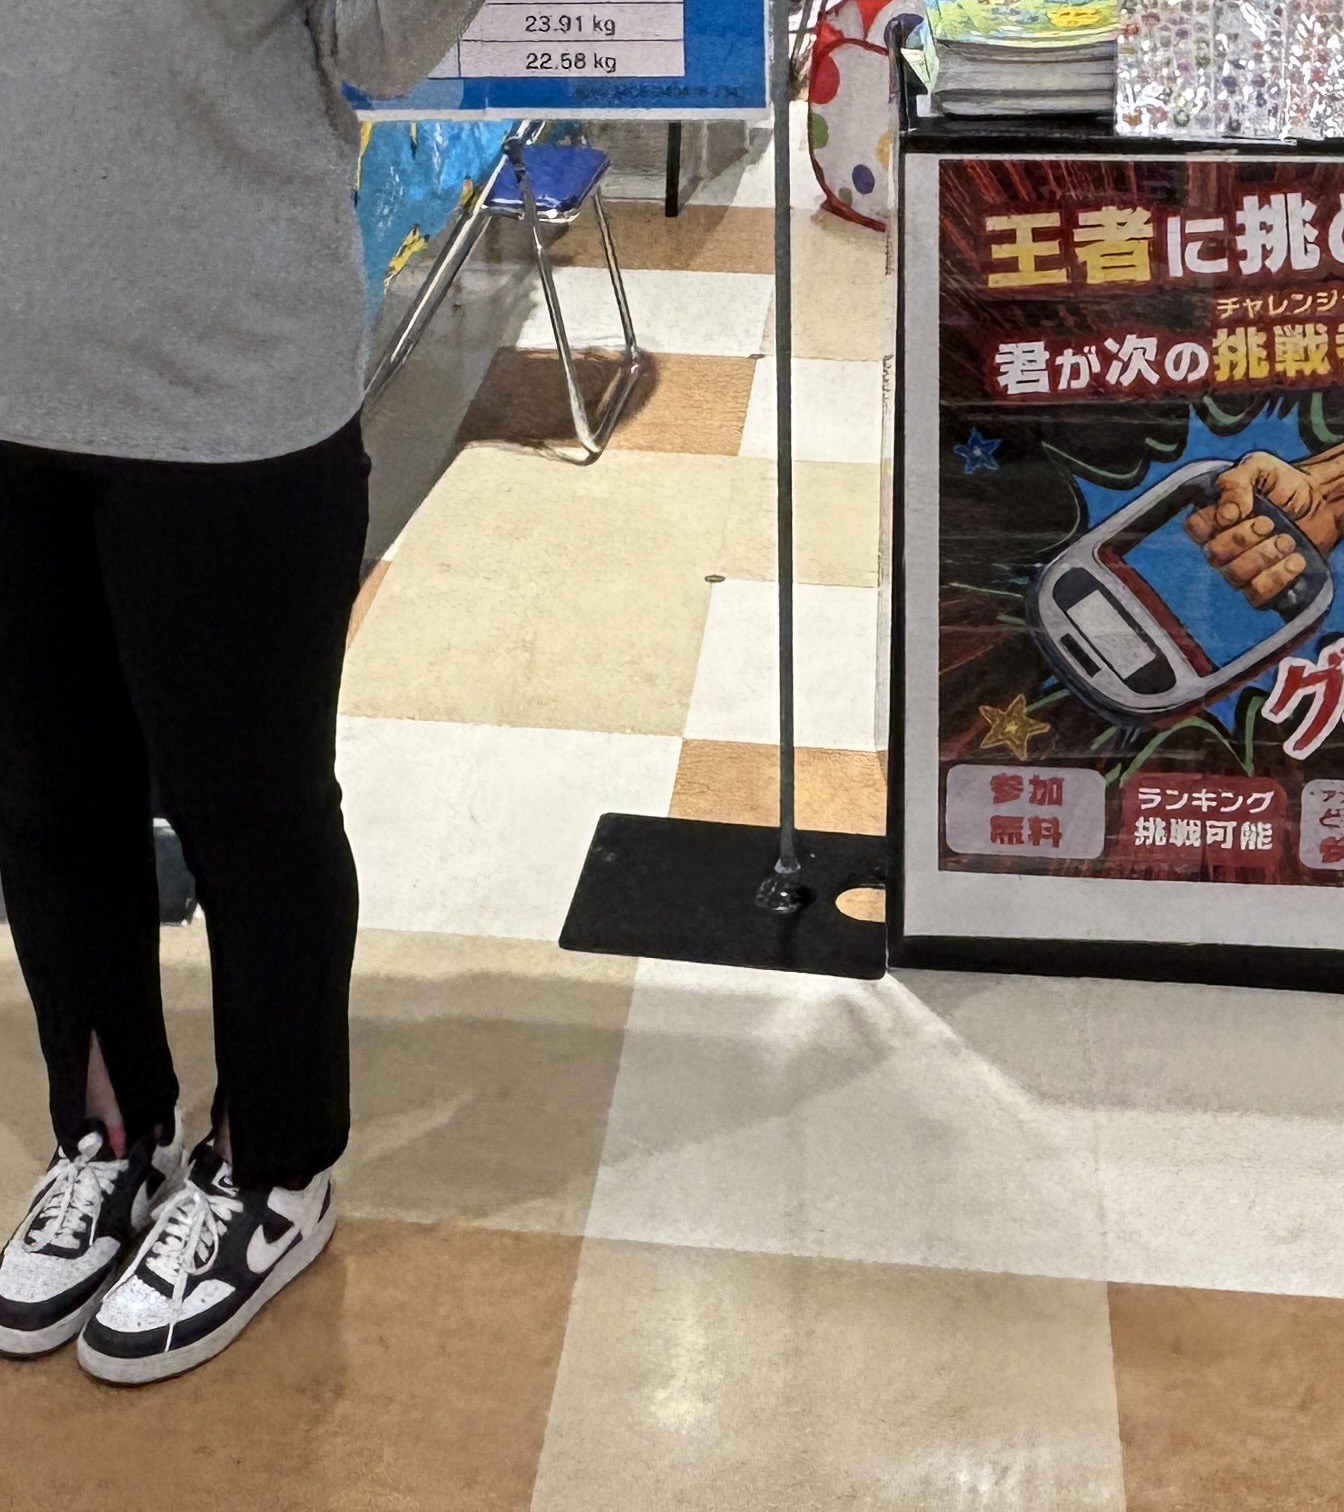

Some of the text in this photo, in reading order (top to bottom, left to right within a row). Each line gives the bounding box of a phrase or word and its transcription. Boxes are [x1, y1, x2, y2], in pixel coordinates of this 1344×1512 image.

[525, 14, 616, 35] 23.91 kg
[594, 53, 616, 73] kg
[989, 773, 1064, 806] 参加
[1137, 787, 1275, 814] ランキング
[1134, 817, 1274, 850] 挑戦可能
